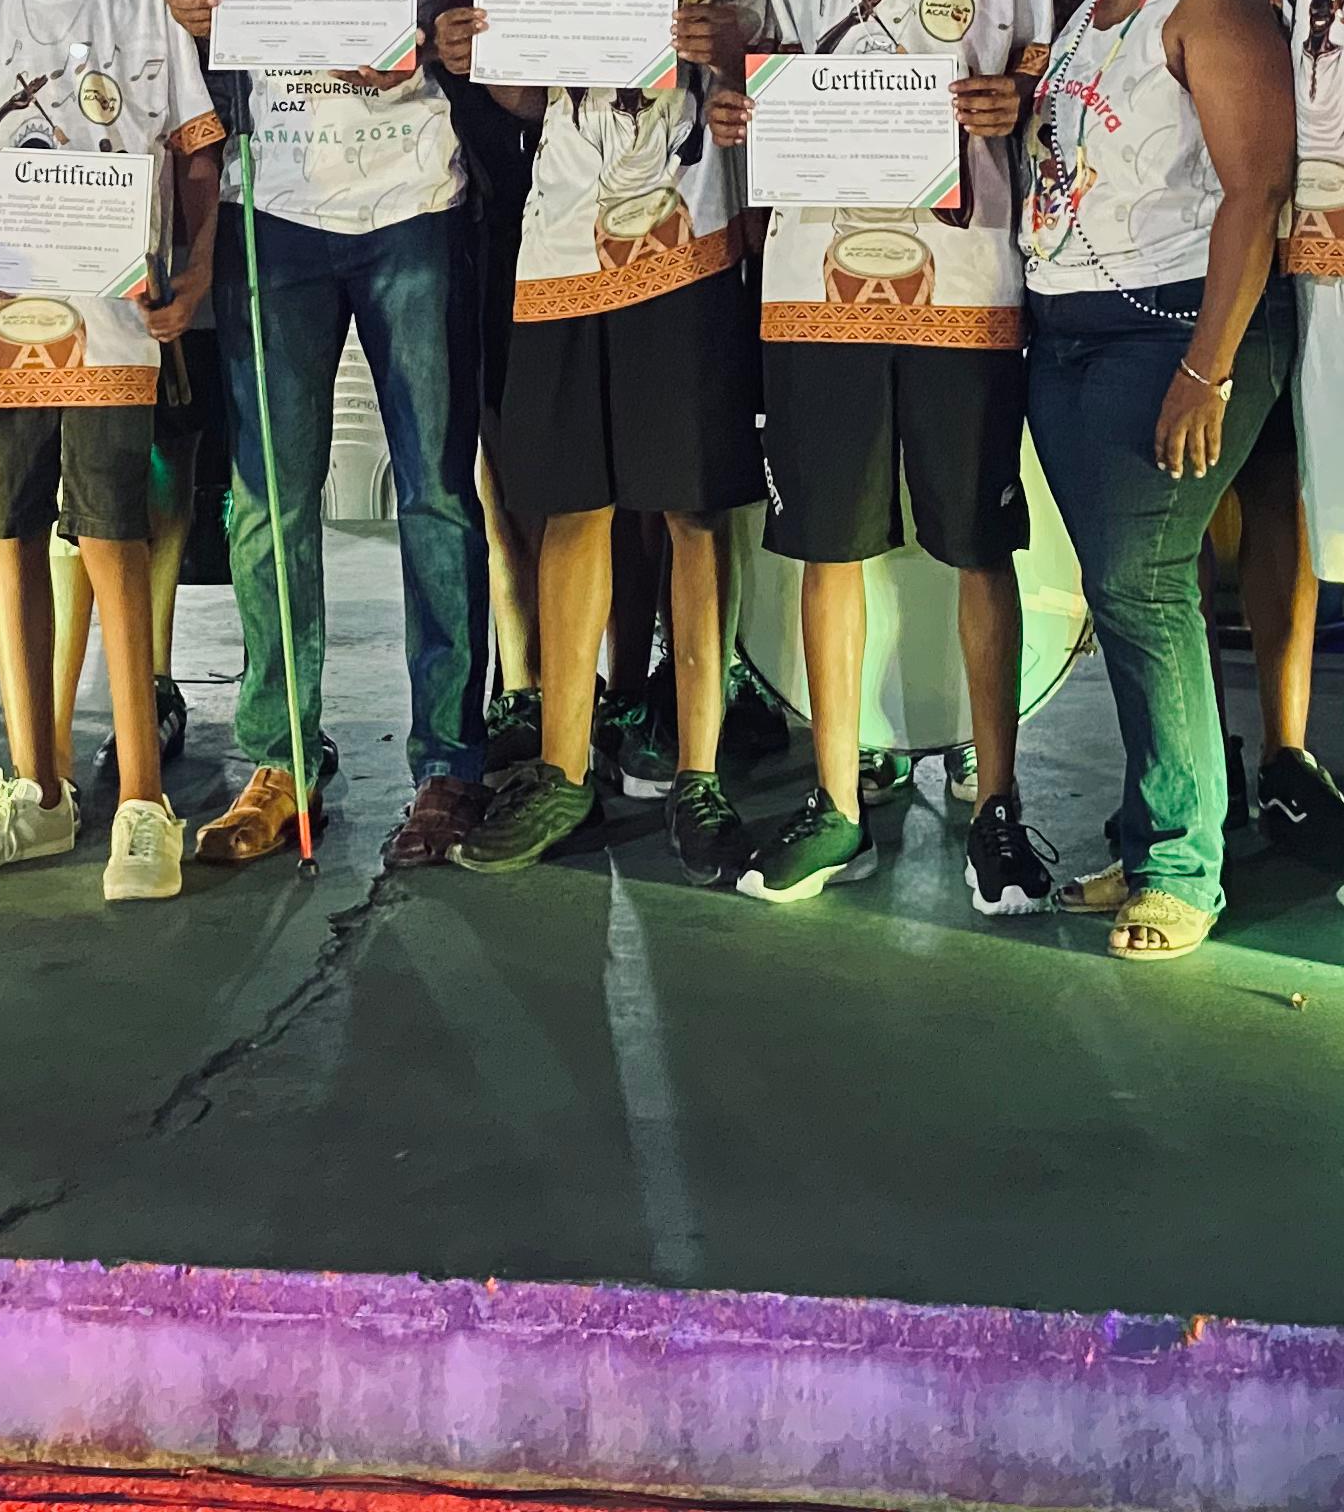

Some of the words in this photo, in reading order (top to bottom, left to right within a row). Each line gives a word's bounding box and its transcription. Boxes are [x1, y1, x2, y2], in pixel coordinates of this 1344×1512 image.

[812, 67, 937, 92] Certificado
[270, 100, 306, 113] ACAZ
[251, 129, 343, 145] ARNAVAL
[355, 124, 413, 143] 2026
[15, 160, 134, 188] Certificado
